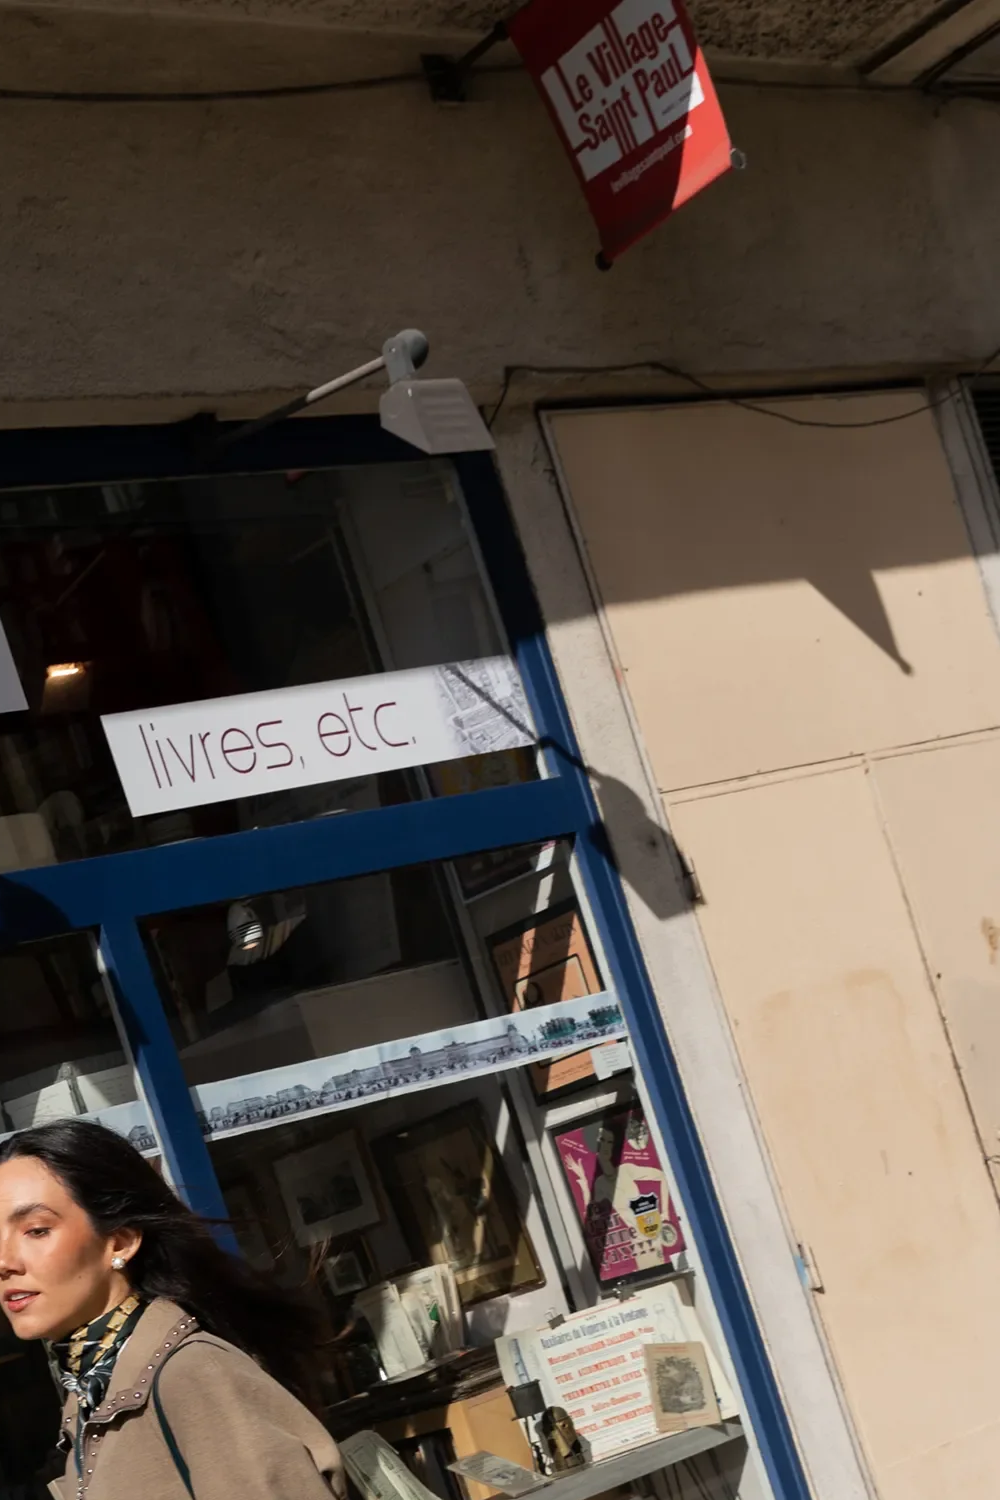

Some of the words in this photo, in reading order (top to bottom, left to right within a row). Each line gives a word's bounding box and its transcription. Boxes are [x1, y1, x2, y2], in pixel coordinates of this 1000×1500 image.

[554, 62, 593, 111] Le
[586, 13, 668, 87] Village
[578, 87, 637, 153] Saint
[632, 44, 688, 126] Paul
